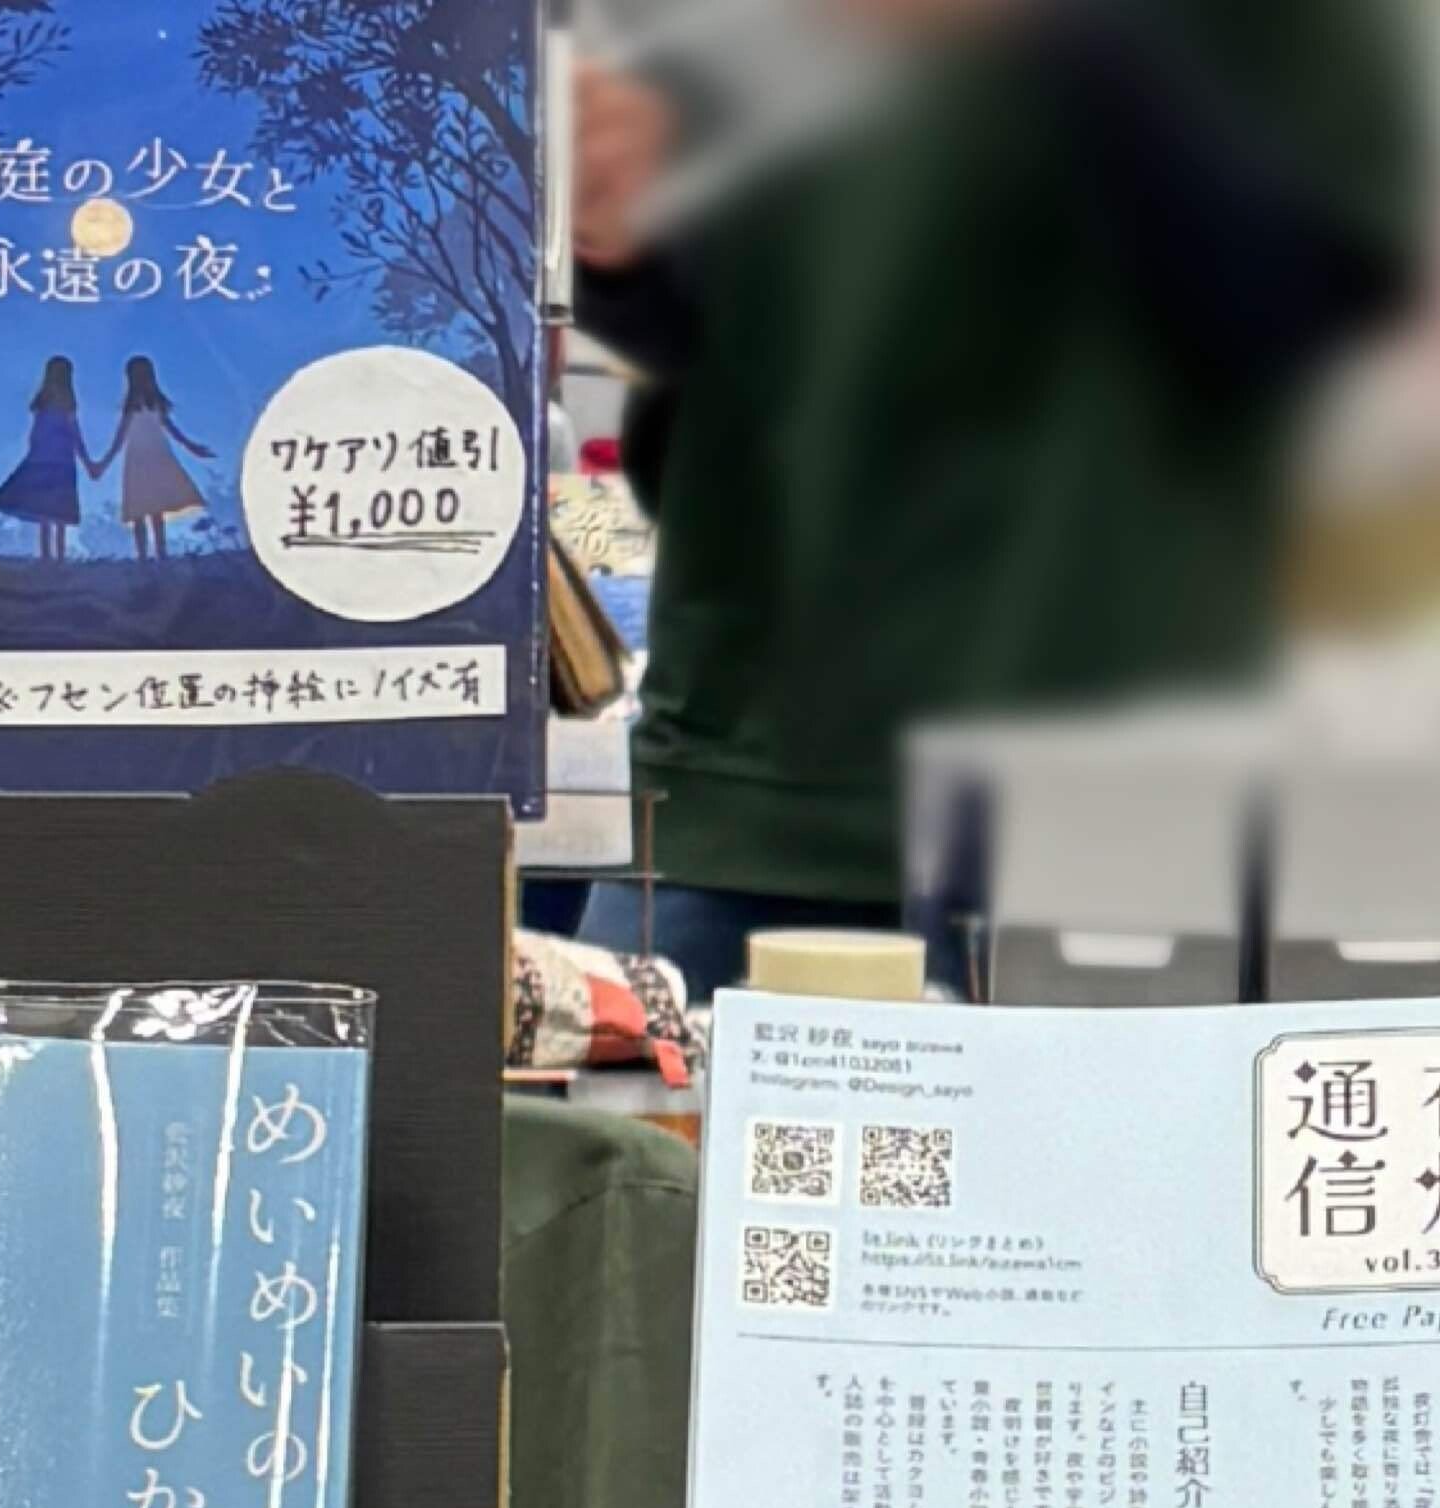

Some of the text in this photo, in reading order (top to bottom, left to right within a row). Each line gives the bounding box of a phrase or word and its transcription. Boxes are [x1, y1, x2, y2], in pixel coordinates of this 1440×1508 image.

[284, 487, 461, 540] ¥1,000
[1282, 1054, 1390, 1239] 通信
[237, 1083, 328, 1482] めいめいの
[1322, 1304, 1389, 1333] Free
